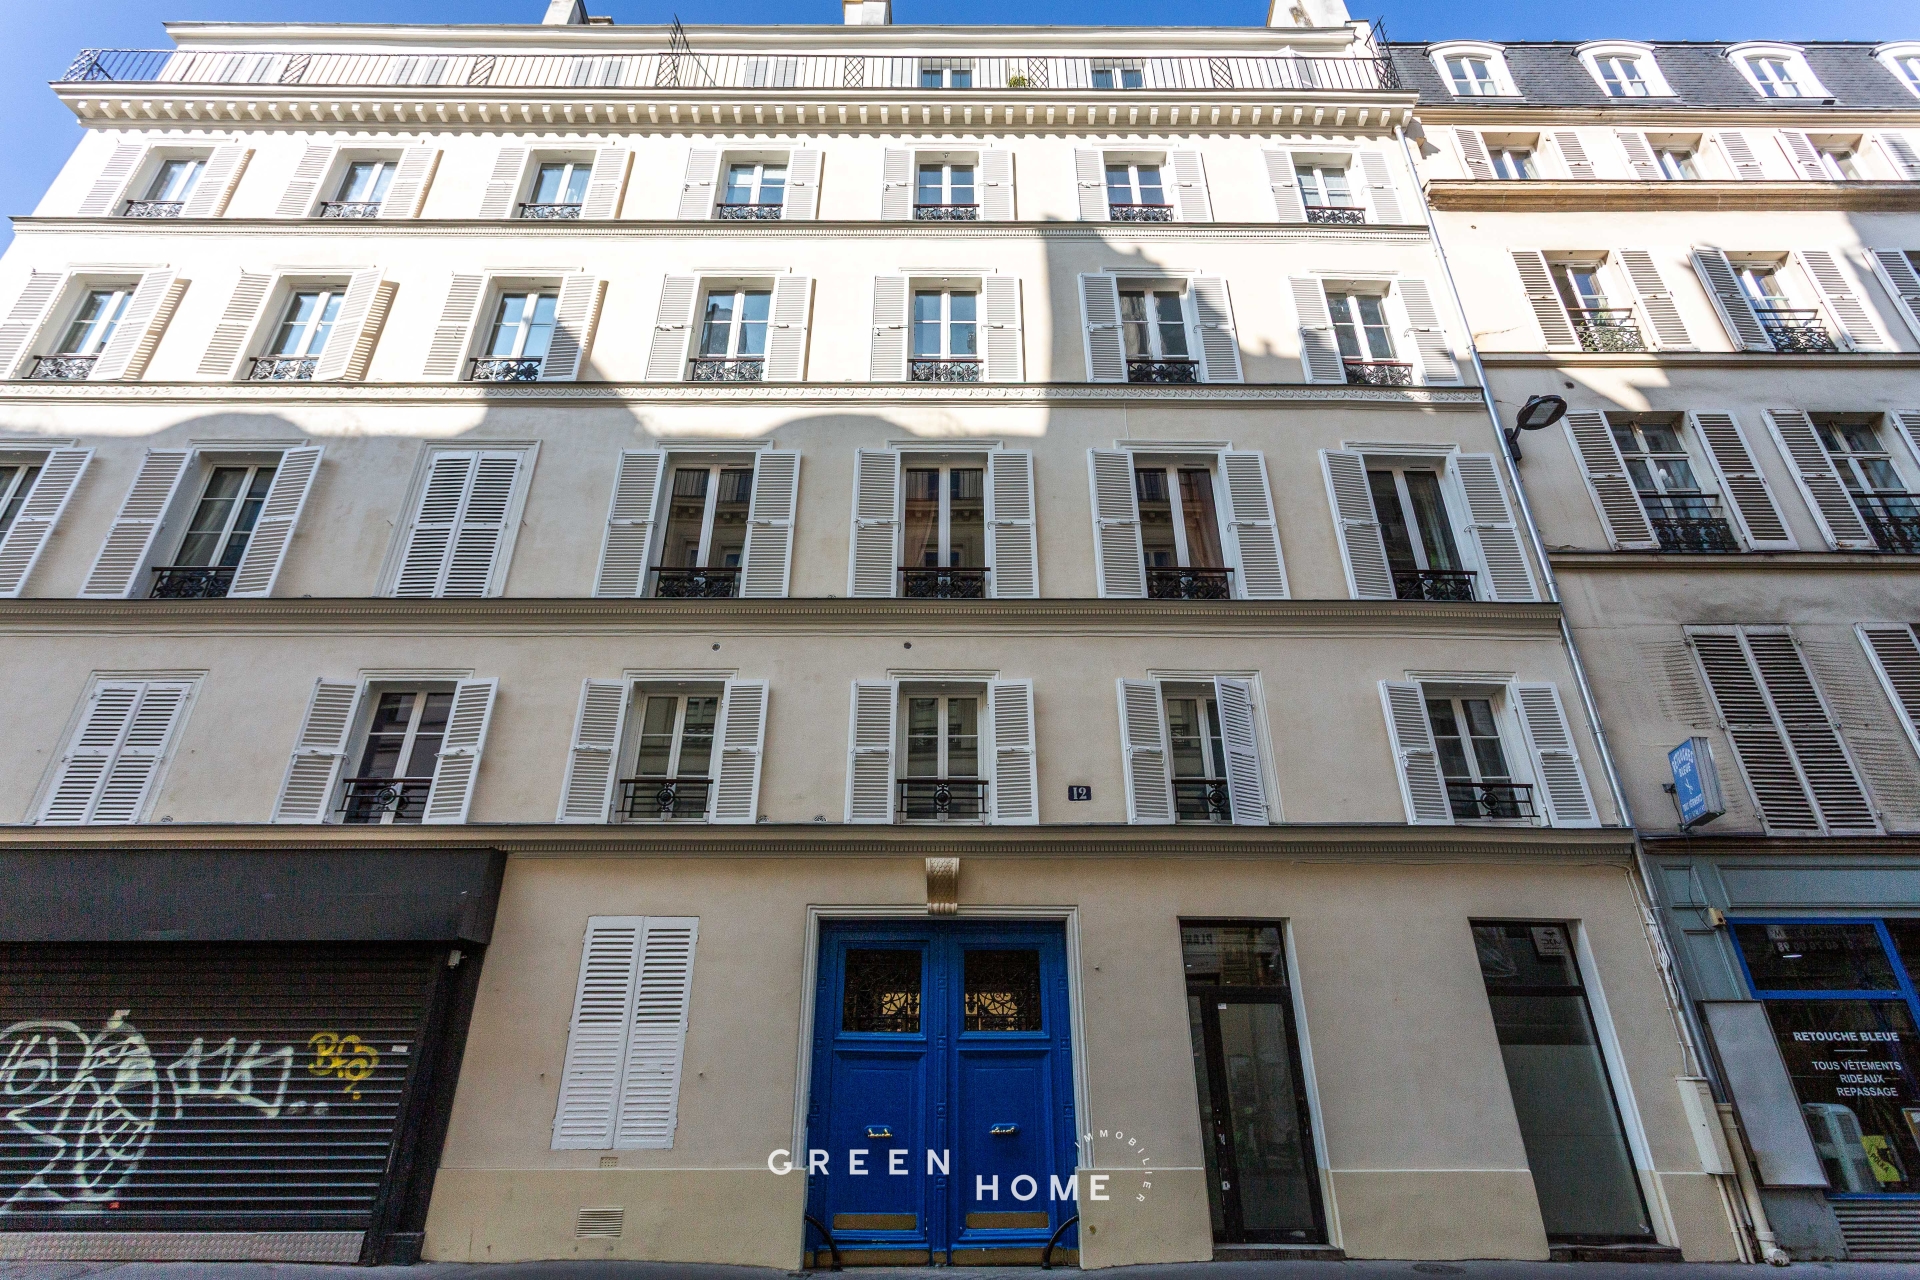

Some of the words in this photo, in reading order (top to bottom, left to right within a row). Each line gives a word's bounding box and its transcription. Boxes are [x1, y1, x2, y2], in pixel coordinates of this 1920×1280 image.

[1073, 787, 1087, 799] 12
[1793, 1032, 1858, 1041] RETOUCHE
[1860, 1032, 1900, 1041] BLEUE
[1812, 1061, 1840, 1070] TOUS
[1841, 1060, 1901, 1070] VÊTEMENTS
[1840, 1074, 1885, 1083] RIDEAUX
[1836, 1087, 1898, 1096] REPASSAGE
